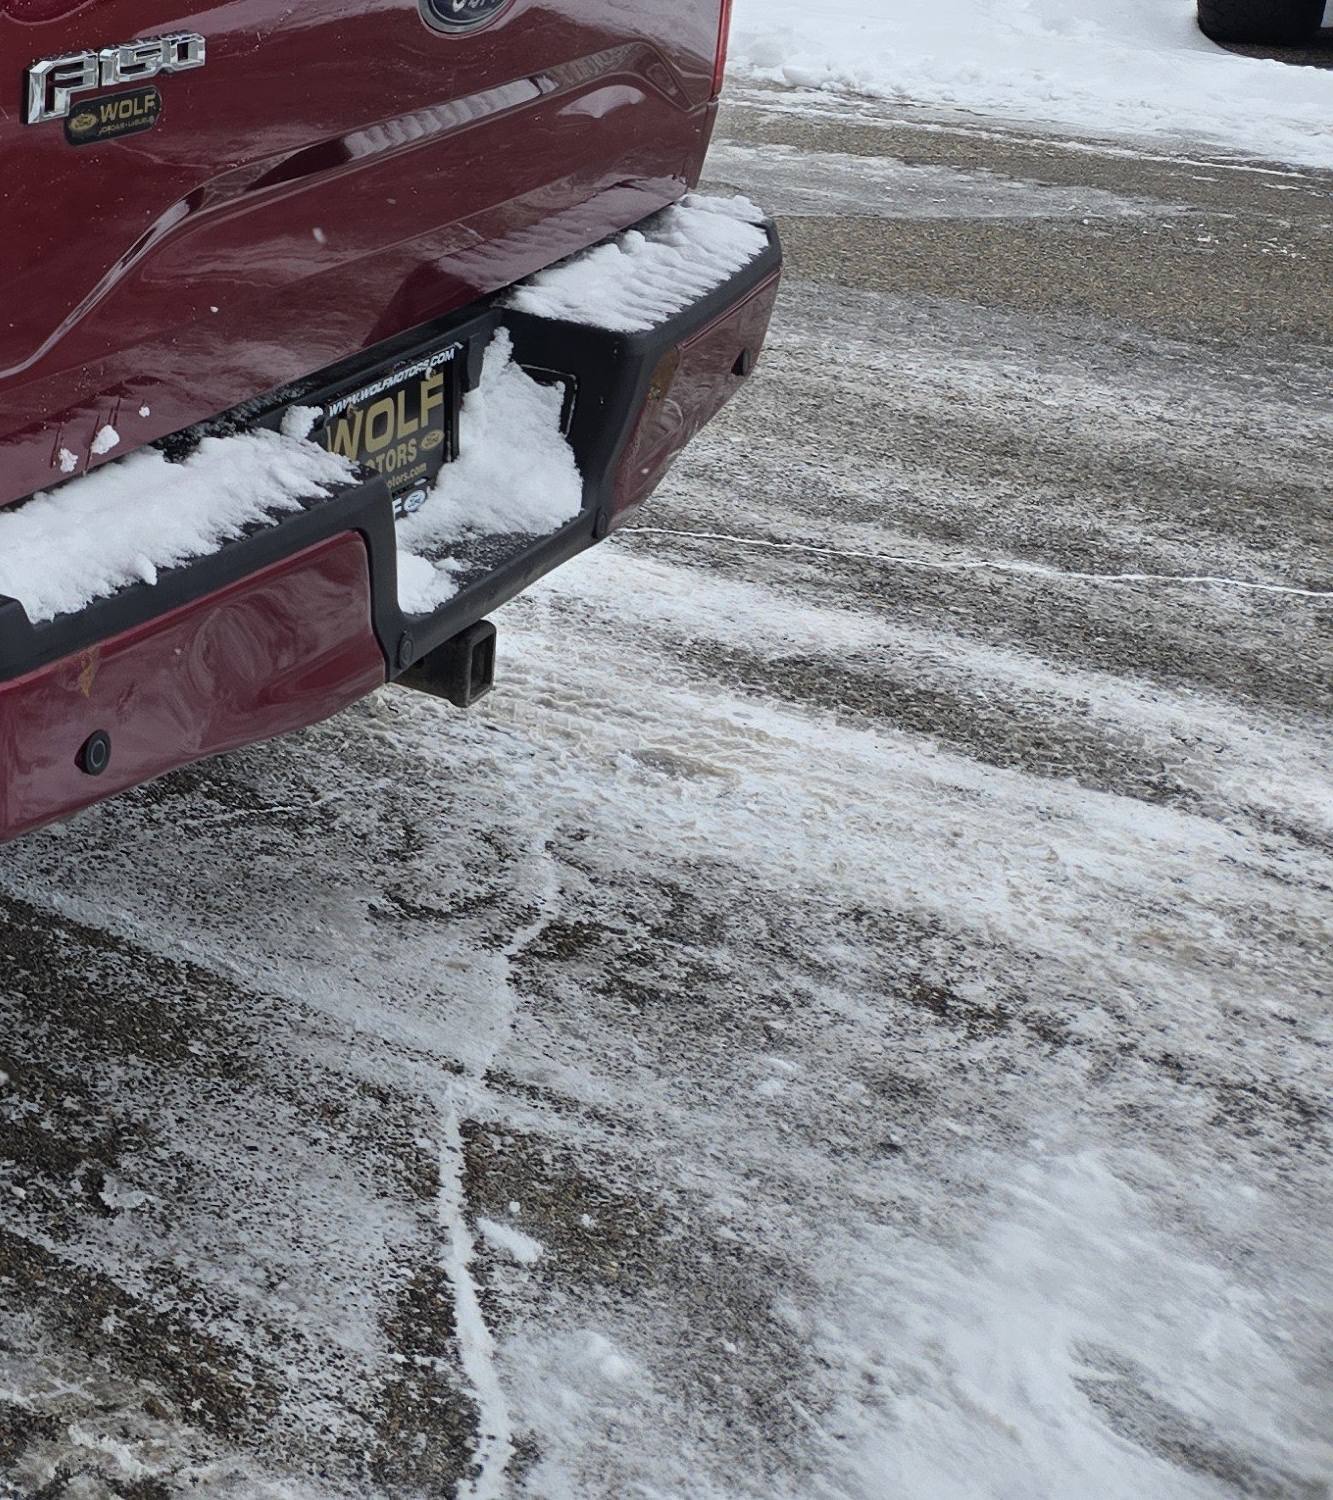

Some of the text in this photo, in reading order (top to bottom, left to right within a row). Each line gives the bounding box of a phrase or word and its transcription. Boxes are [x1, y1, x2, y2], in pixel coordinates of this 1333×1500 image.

[100, 93, 156, 123] WOLF
[326, 372, 444, 462] WOLF
[365, 438, 417, 474] TORS
[386, 462, 428, 489] otors.com
